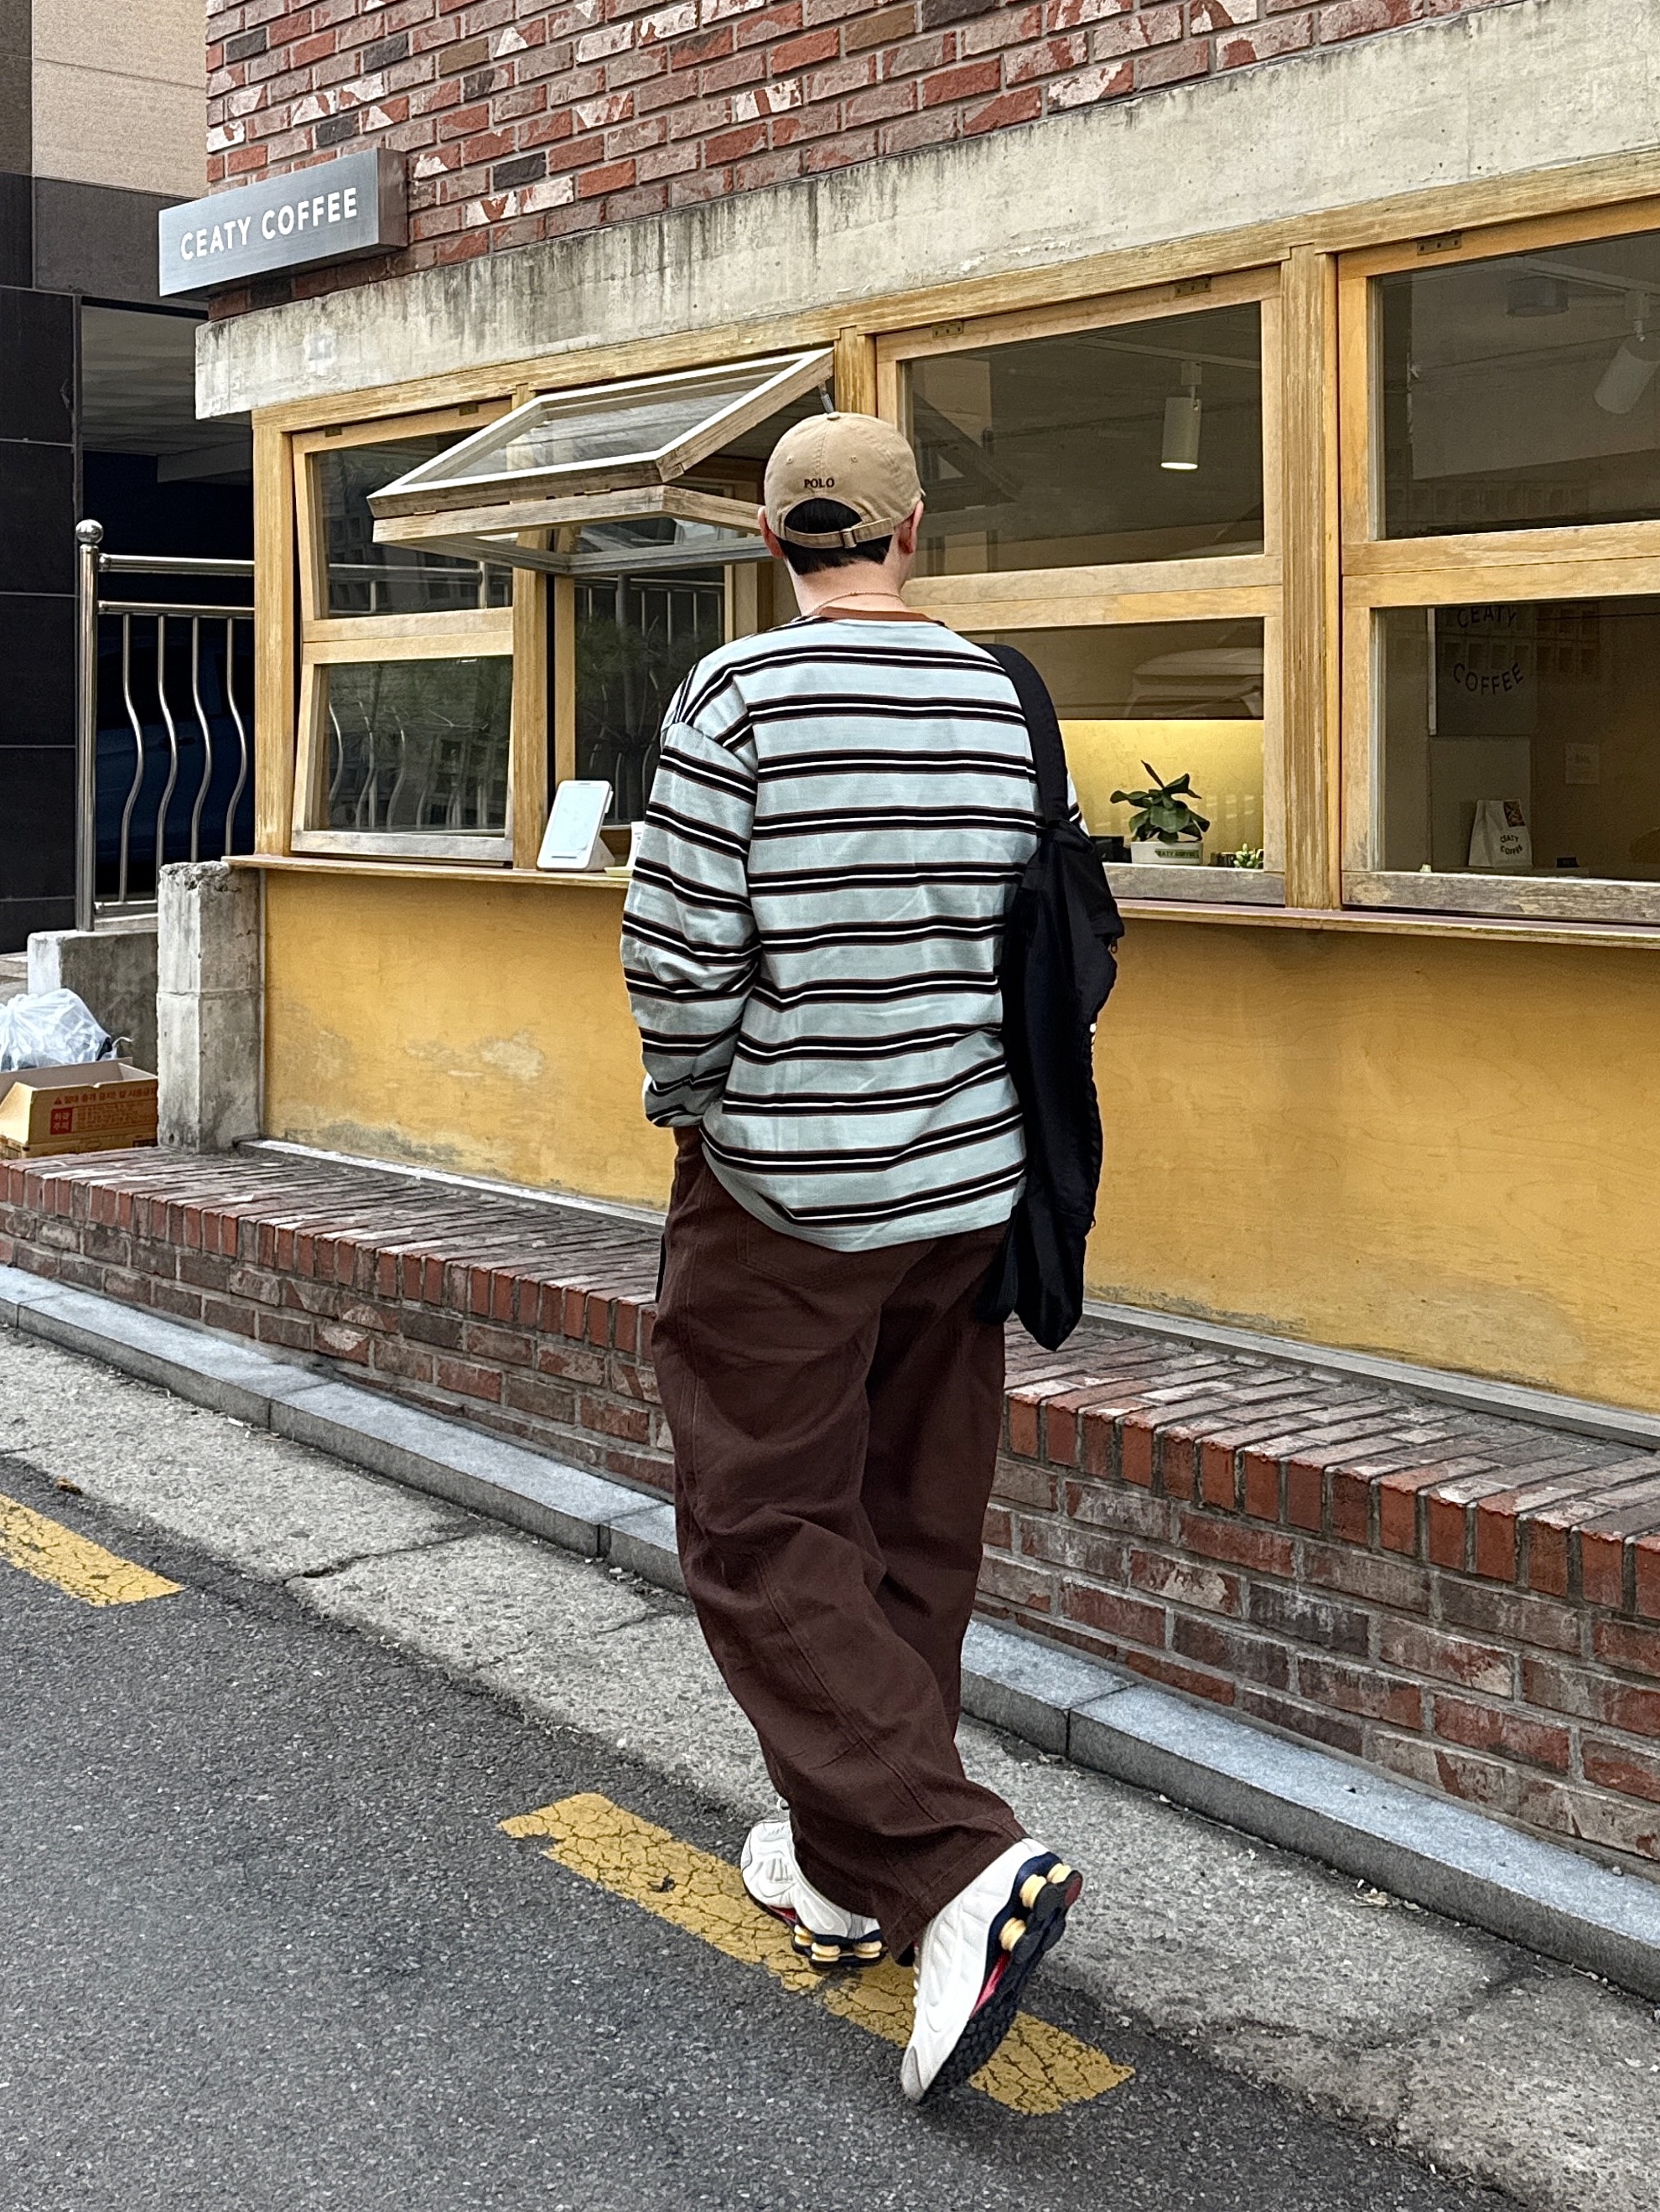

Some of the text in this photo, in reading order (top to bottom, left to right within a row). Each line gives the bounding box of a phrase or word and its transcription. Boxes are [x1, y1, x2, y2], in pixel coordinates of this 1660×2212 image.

[180, 187, 357, 261] CEATY COFFEE
[804, 478, 835, 488] POLO
[1456, 605, 1517, 628] CEATY
[1453, 662, 1524, 695] COFFEE
